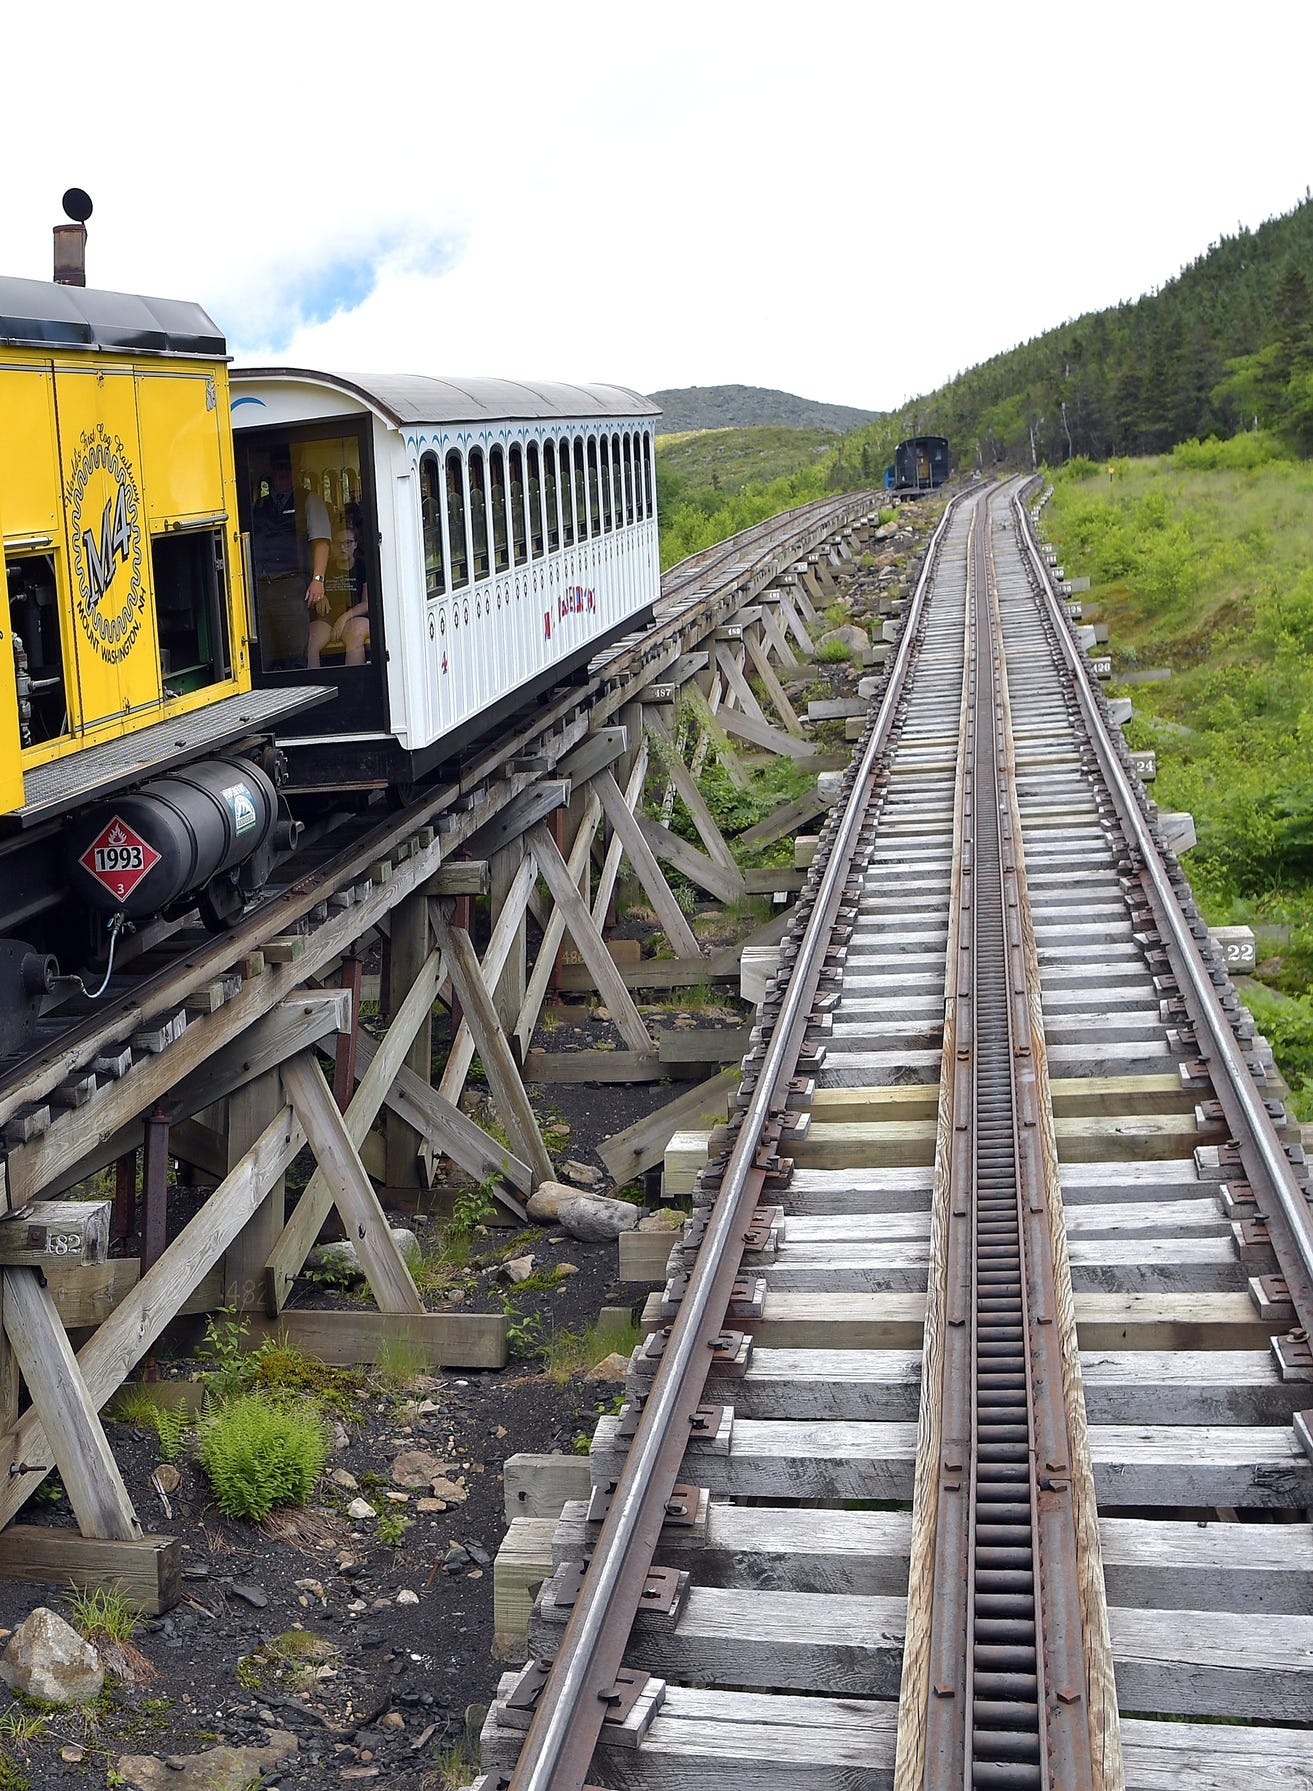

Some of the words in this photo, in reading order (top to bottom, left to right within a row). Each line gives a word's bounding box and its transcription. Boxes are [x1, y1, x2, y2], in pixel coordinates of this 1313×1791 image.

[96, 422, 112, 450] Cog
[114, 434, 141, 504] Railway
[82, 482, 132, 607] M4
[77, 600, 100, 653] MOUNT
[100, 619, 142, 664] WASHINGTON,
[138, 586, 147, 615] NH
[96, 846, 143, 871] 1993
[117, 883, 125, 894] 3
[1222, 944, 1254, 961] 22
